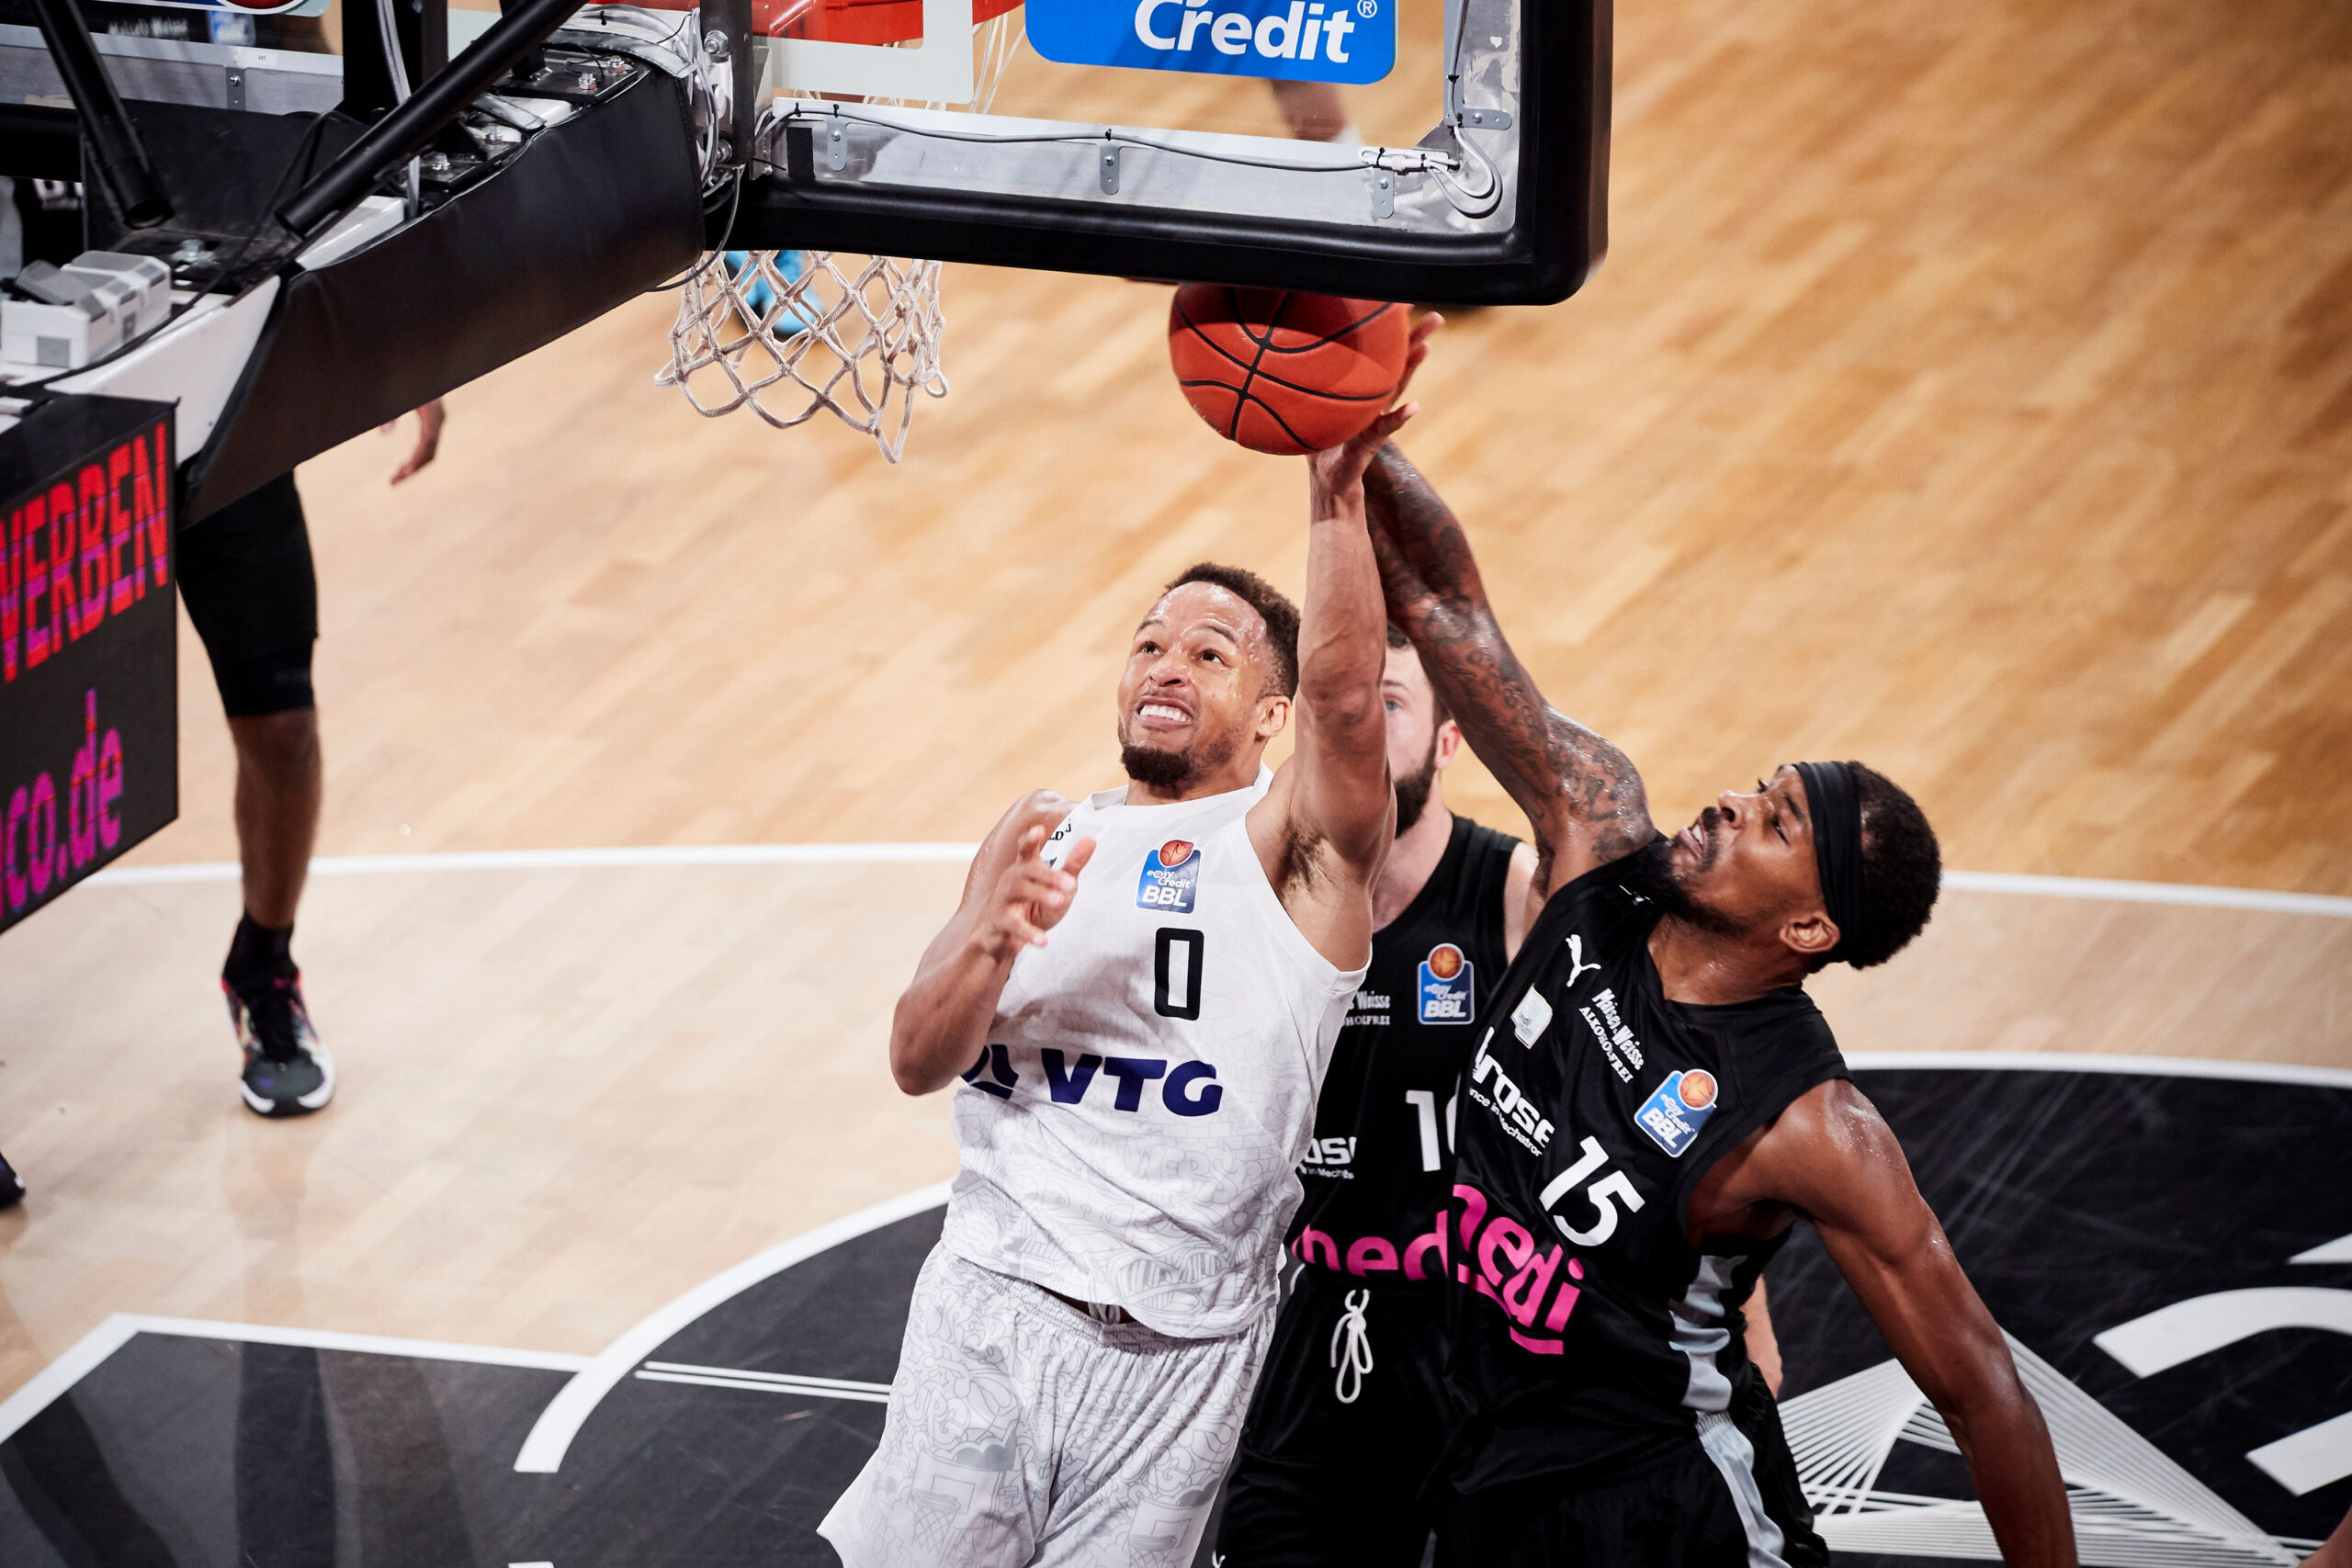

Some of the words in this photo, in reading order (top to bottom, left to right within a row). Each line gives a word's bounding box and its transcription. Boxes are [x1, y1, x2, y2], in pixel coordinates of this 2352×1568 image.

[0, 689, 124, 917] co.de
[1142, 885, 1188, 908] BBL
[1154, 927, 1204, 1021] 0
[1344, 1015, 1391, 1027] HOLFREI
[1356, 990, 1391, 1010] Weisse
[1424, 999, 1467, 1018] BBL
[1611, 1024, 1645, 1071] Weisse
[1041, 1047, 1224, 1117] VTG
[1641, 1106, 1682, 1148] BBL
[1539, 1135, 1645, 1247] 15
